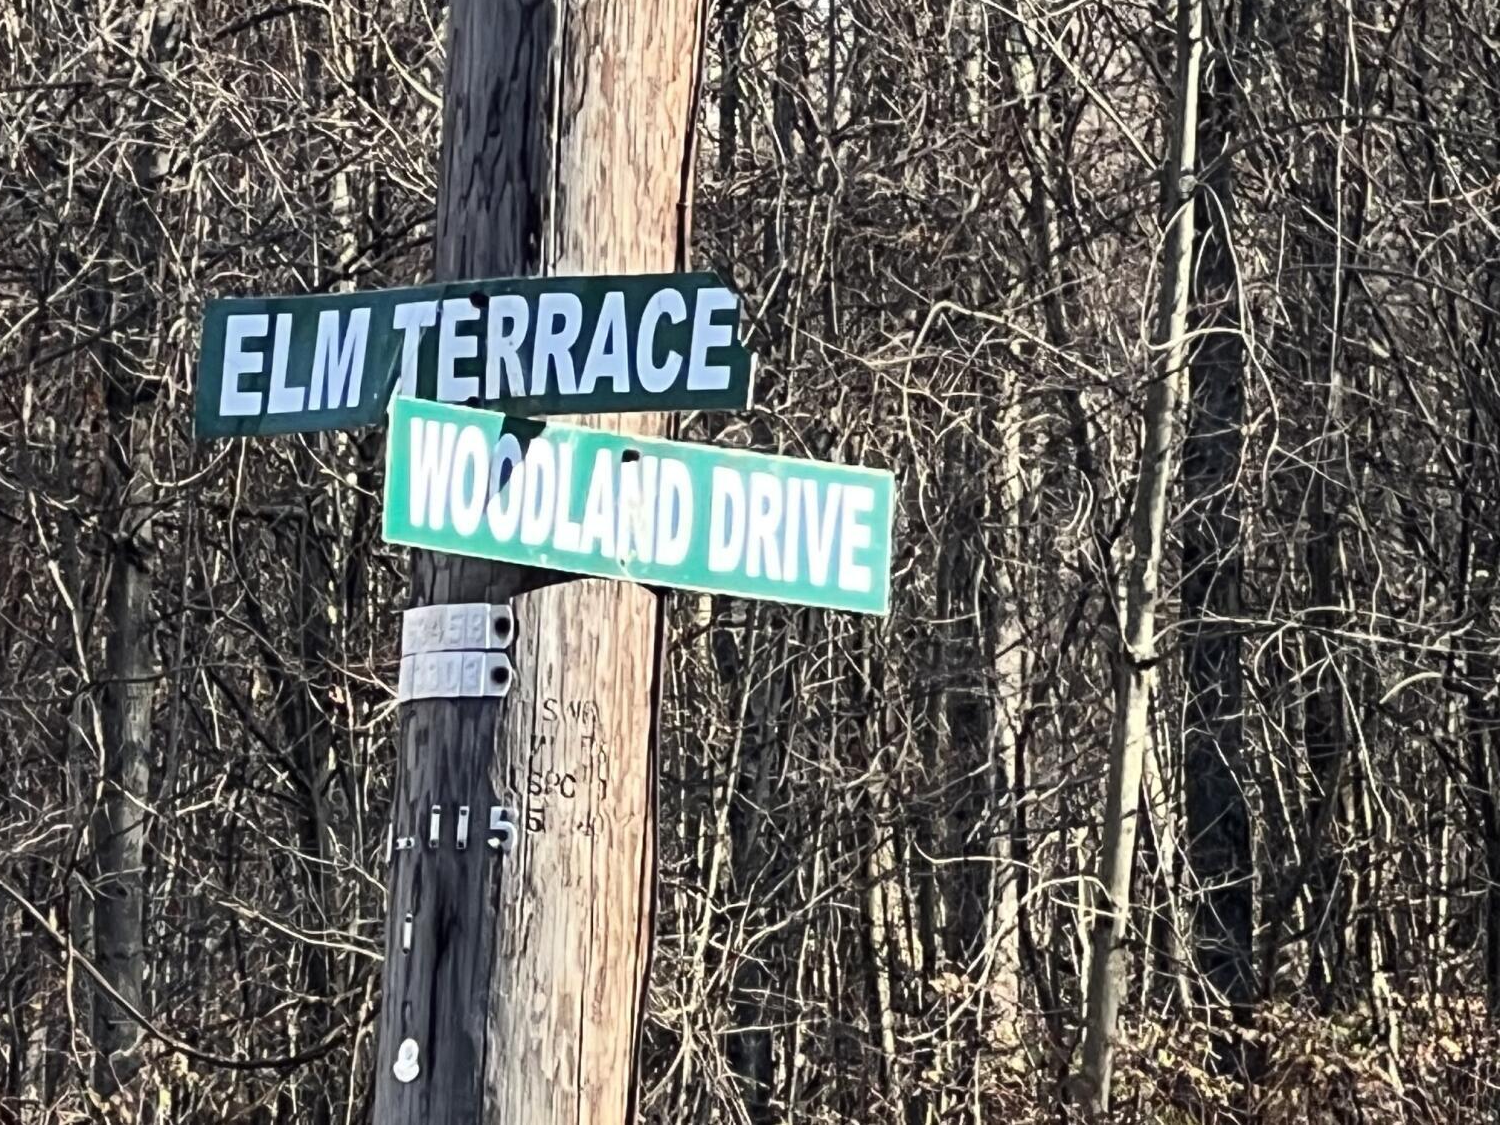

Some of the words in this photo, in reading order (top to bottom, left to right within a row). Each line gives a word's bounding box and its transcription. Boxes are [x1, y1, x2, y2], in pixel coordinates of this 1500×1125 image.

[218, 307, 372, 417] ELM
[392, 286, 739, 404] TERRACE
[408, 416, 693, 566] WOODLAND
[707, 459, 876, 592] DRIVE
